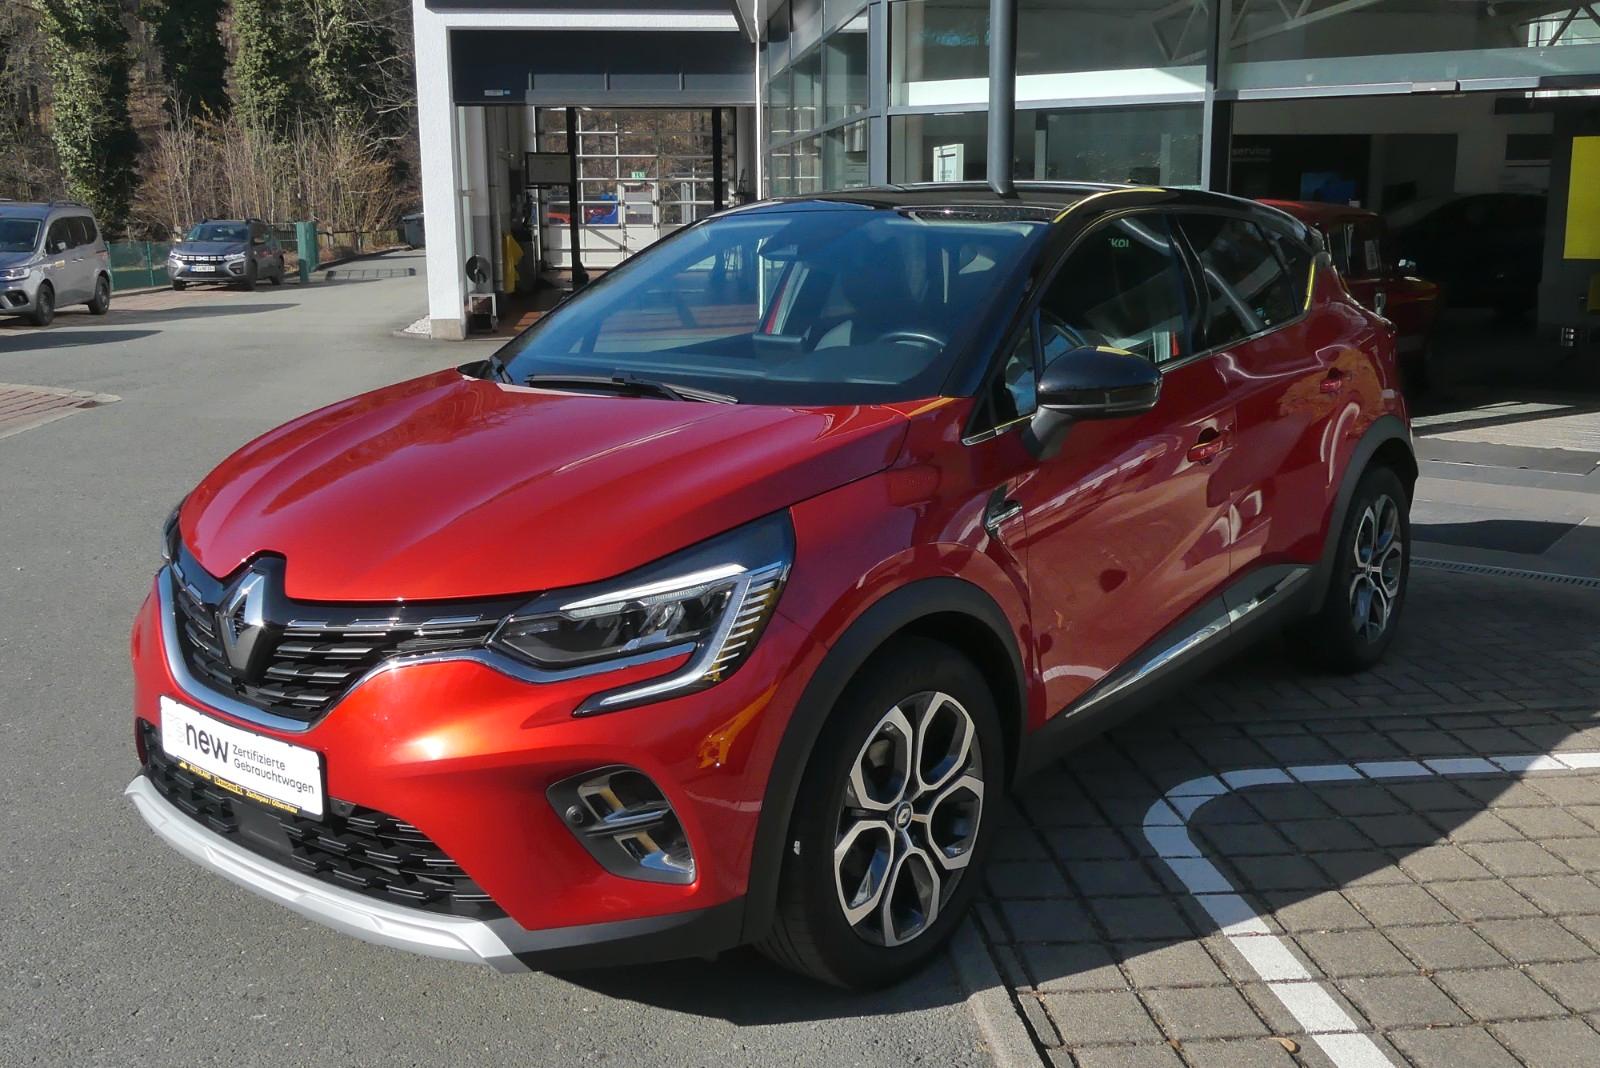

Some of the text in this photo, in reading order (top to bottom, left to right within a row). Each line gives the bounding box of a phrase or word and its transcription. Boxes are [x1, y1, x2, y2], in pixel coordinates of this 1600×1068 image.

[185, 722, 229, 763] new
[232, 744, 286, 771] Zertifizierte
[233, 758, 315, 794] Gebrauchtwagen
